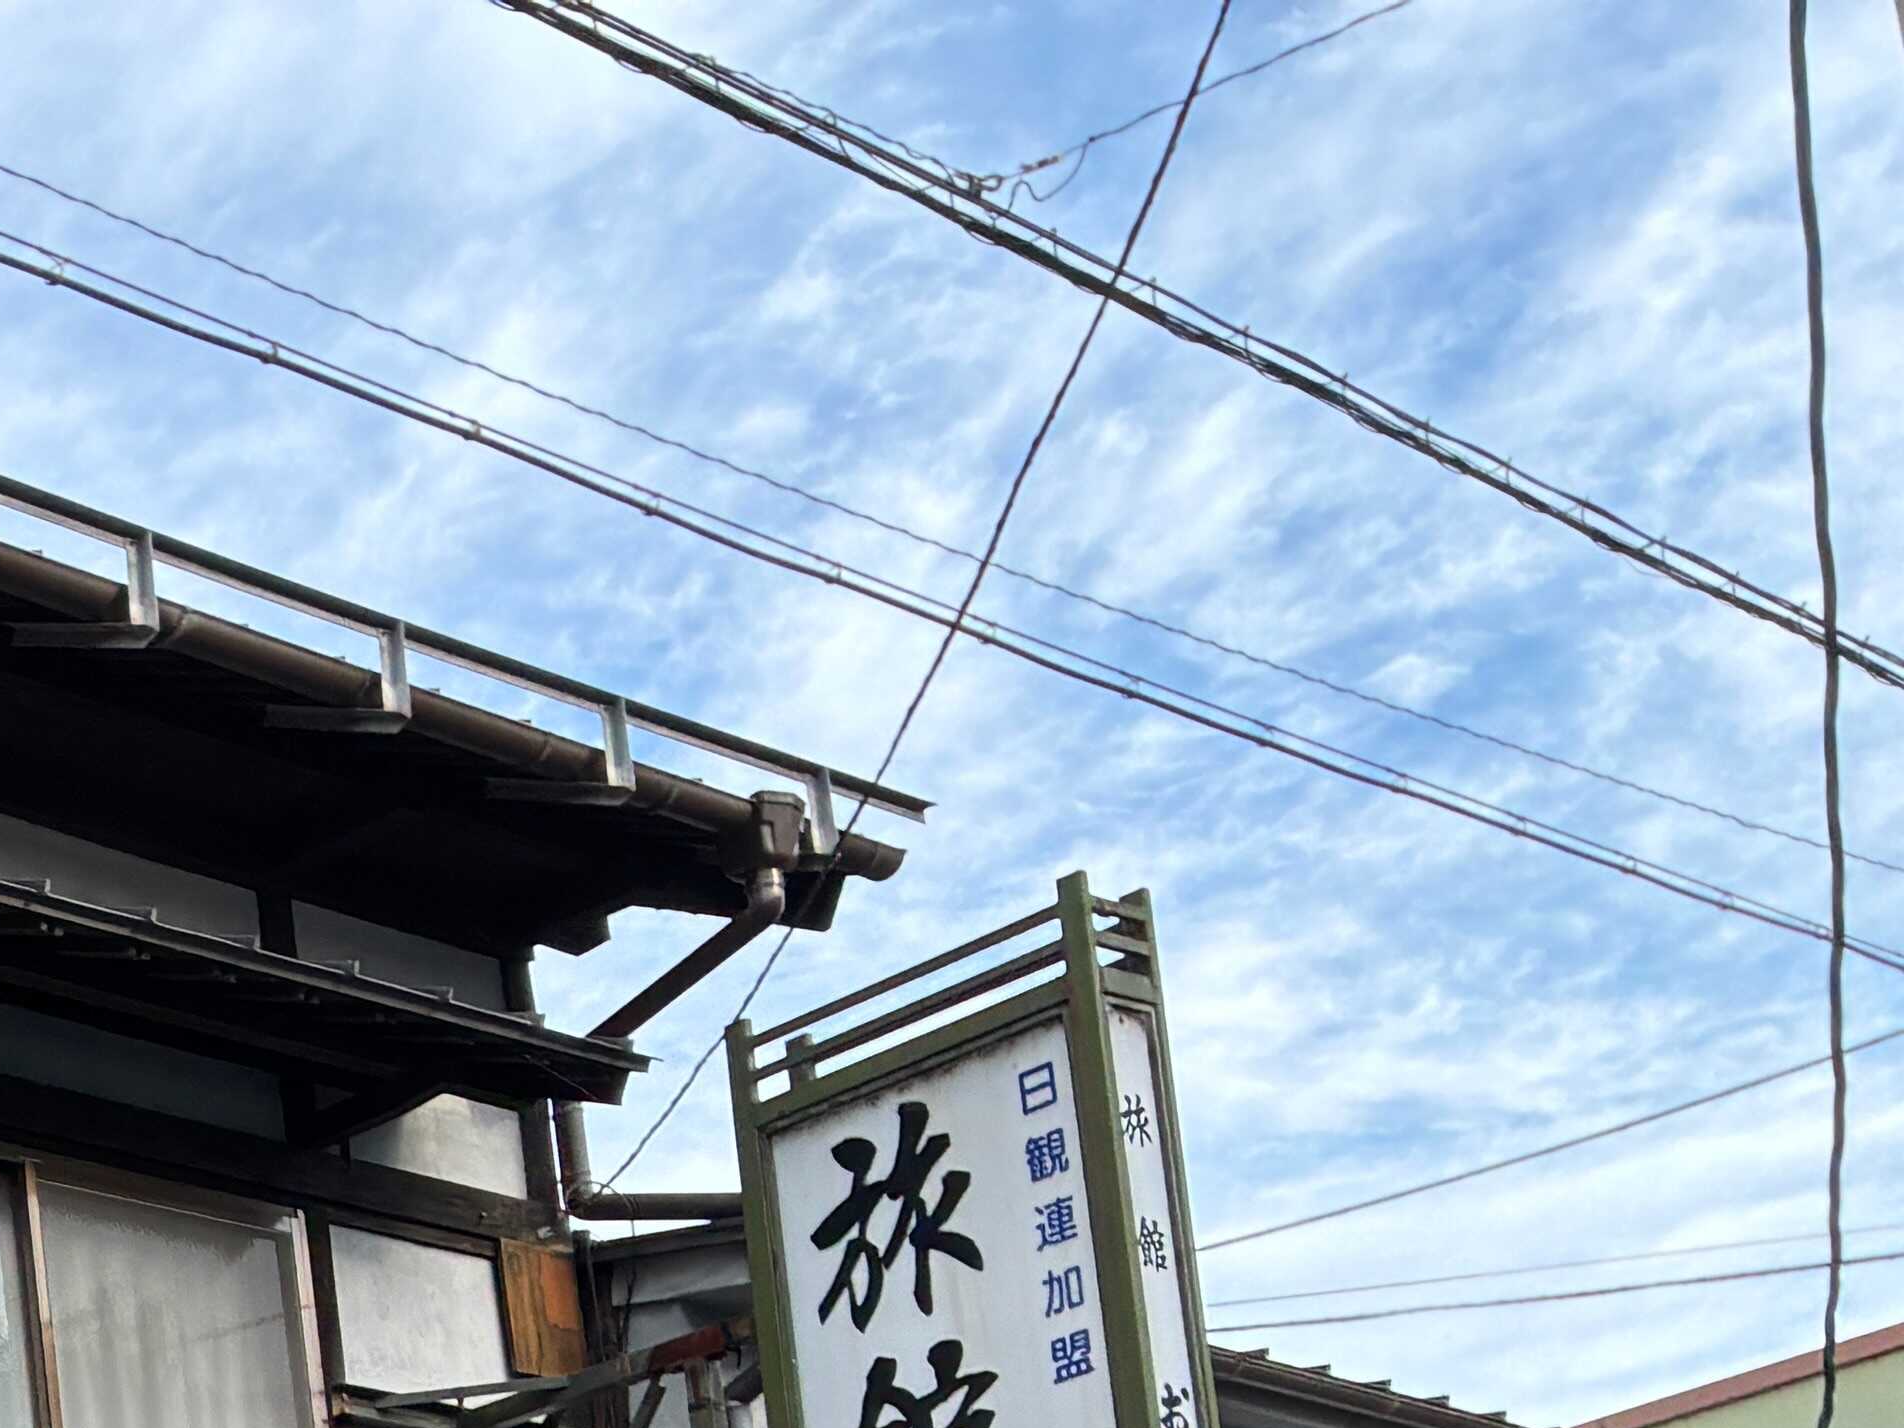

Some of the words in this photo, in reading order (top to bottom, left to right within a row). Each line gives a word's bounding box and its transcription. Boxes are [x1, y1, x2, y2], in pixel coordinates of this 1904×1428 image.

[1018, 1061, 1094, 1385] 日観連加盟
[1120, 1093, 1169, 1273] 旅館
